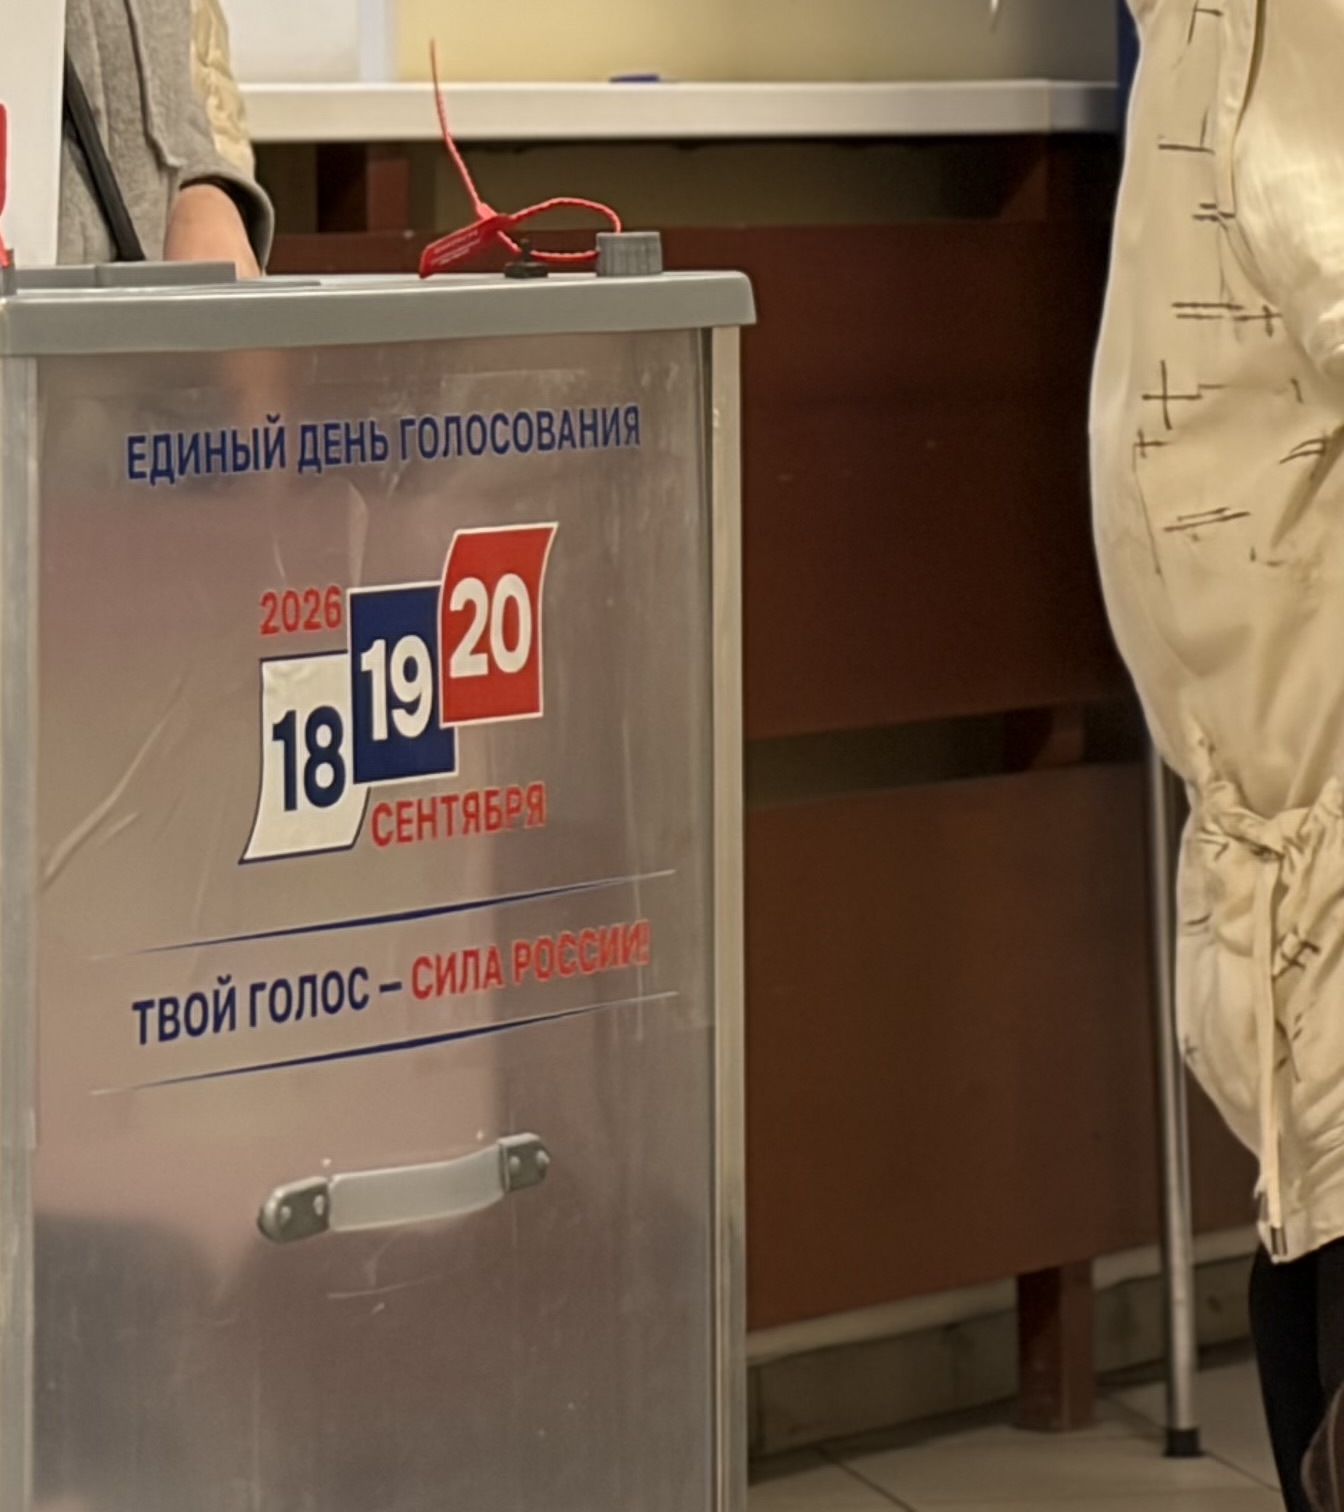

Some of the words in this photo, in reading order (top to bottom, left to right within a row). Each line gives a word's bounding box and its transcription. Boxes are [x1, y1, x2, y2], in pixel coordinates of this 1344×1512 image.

[126, 412, 287, 486] ЕДИНЫЙ
[297, 419, 389, 474] ДЕНЬ
[399, 404, 641, 461] ГОЛОСОВАНИЯ
[259, 584, 343, 636] 2026
[271, 704, 346, 812] 18
[360, 634, 433, 742] 19
[449, 572, 532, 679] 20
[370, 781, 547, 847] СЕНТЯБРЯ
[131, 974, 237, 1046] ТВОЙ
[249, 966, 370, 1029] ГОЛОС
[410, 945, 504, 1000] СИЛА
